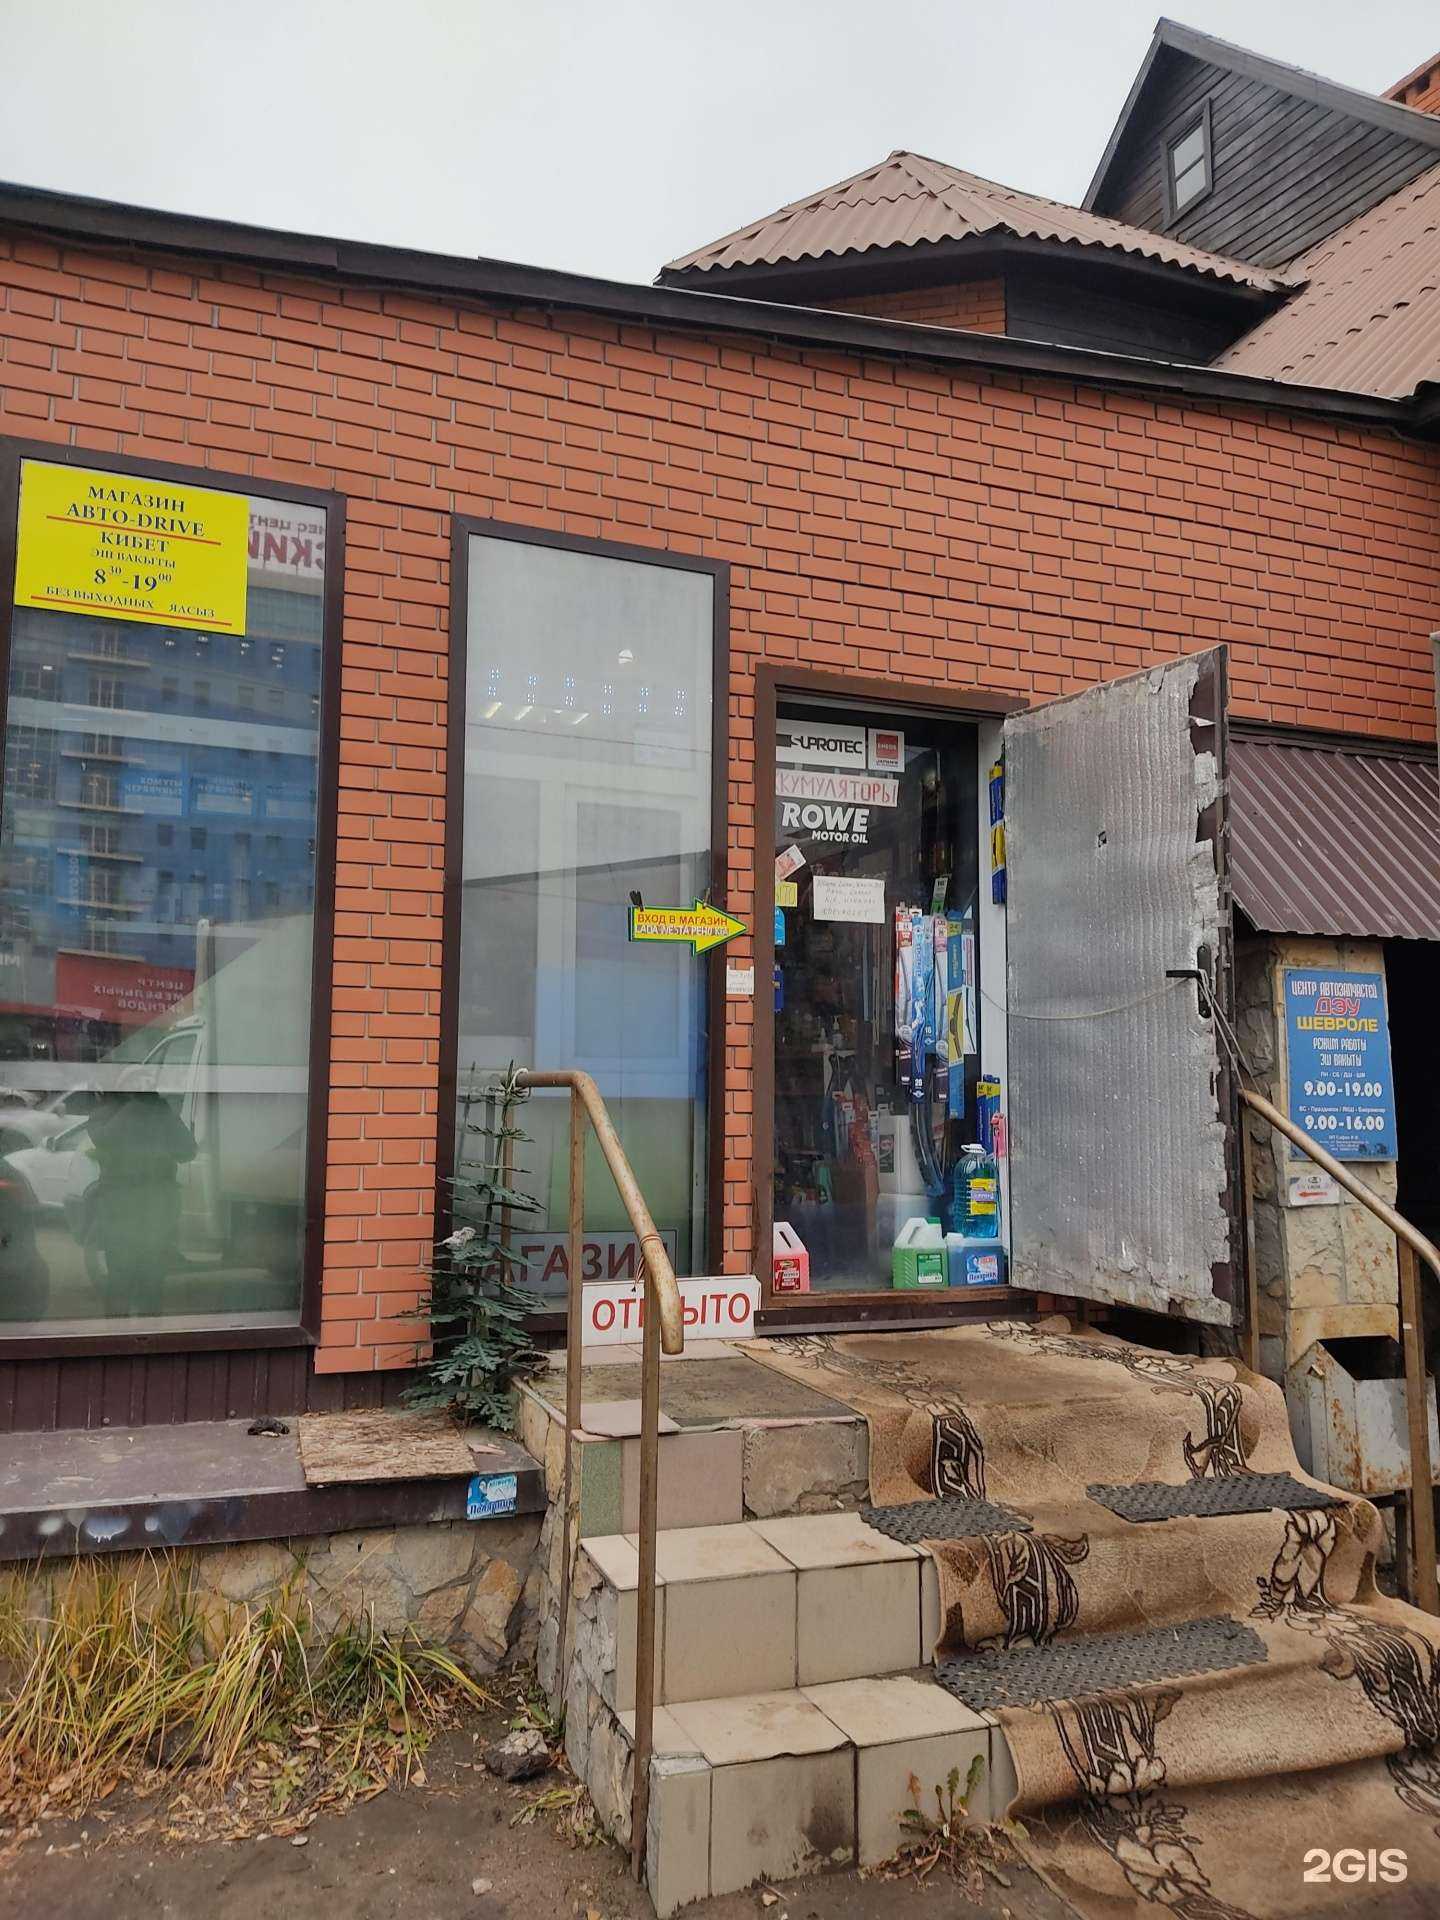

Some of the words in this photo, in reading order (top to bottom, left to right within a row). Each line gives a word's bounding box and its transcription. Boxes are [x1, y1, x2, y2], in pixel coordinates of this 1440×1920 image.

[88, 485, 185, 513] МАГАЗИН
[67, 503, 205, 537] АВТО-DRIVE
[100, 531, 170, 553] КИБЕТ
[789, 735, 863, 755] SUPROTEC
[781, 801, 870, 833] ROWE
[811, 830, 849, 843] MOTOR
[851, 834, 869, 845] OIL
[637, 913, 666, 926] ВХОД
[669, 915, 676, 924] В
[680, 916, 728, 927] МАГАЗИН
[1291, 981, 1317, 997] ЦЕНТР
[1320, 982, 1378, 1000] АВТОЗАПЧАСТЕЙ
[1314, 997, 1361, 1016] ДЭУ
[1297, 1015, 1379, 1033] ШЕВРОЛЕ
[1313, 1037, 1339, 1051] РЕЖИМ
[1341, 1037, 1367, 1052] РАБОТЫ
[1320, 1053, 1332, 1066] ЭШ
[1333, 1054, 1362, 1067] ВАКЫТЫ
[1303, 1080, 1383, 1098] 9.00-19.00
[1304, 1114, 1385, 1131] 9.00-16.00
[591, 1292, 751, 1331] ОТЫТО
